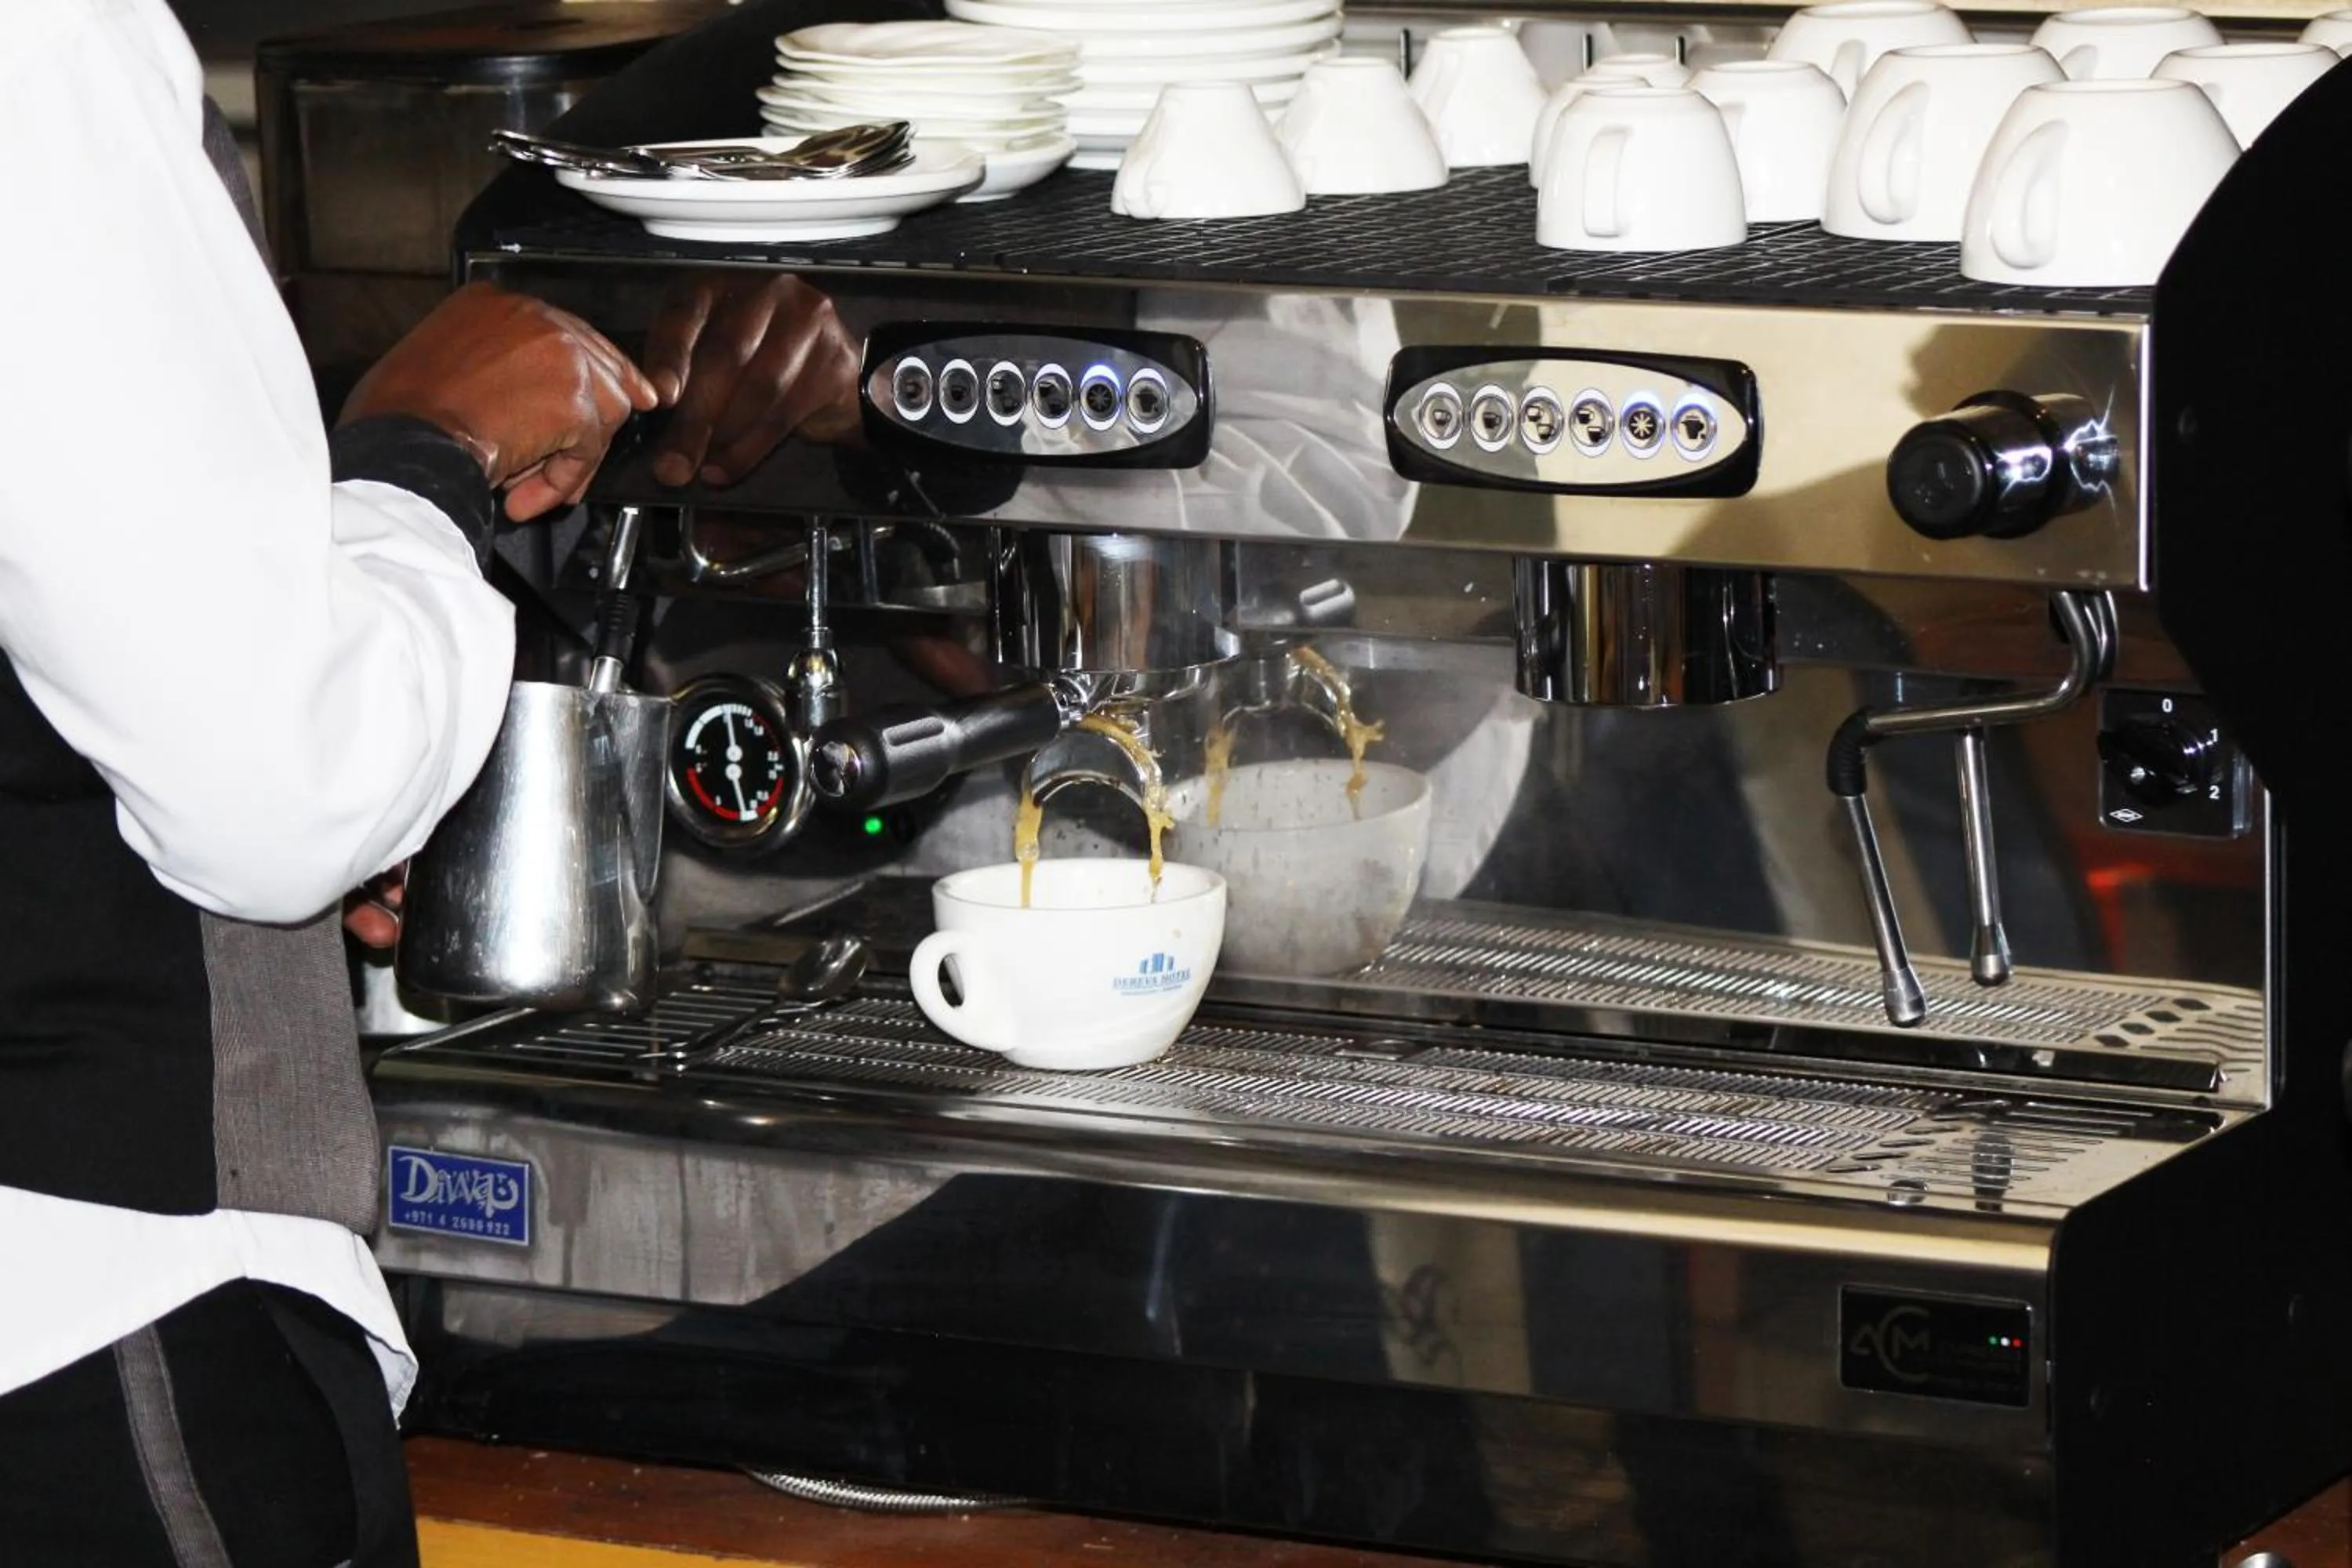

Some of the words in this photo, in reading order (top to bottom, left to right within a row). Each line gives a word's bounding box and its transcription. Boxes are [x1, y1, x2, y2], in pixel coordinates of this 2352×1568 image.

[2161, 698, 2173, 713] 0
[2209, 728, 2219, 742] 1
[2209, 785, 2220, 800] 2
